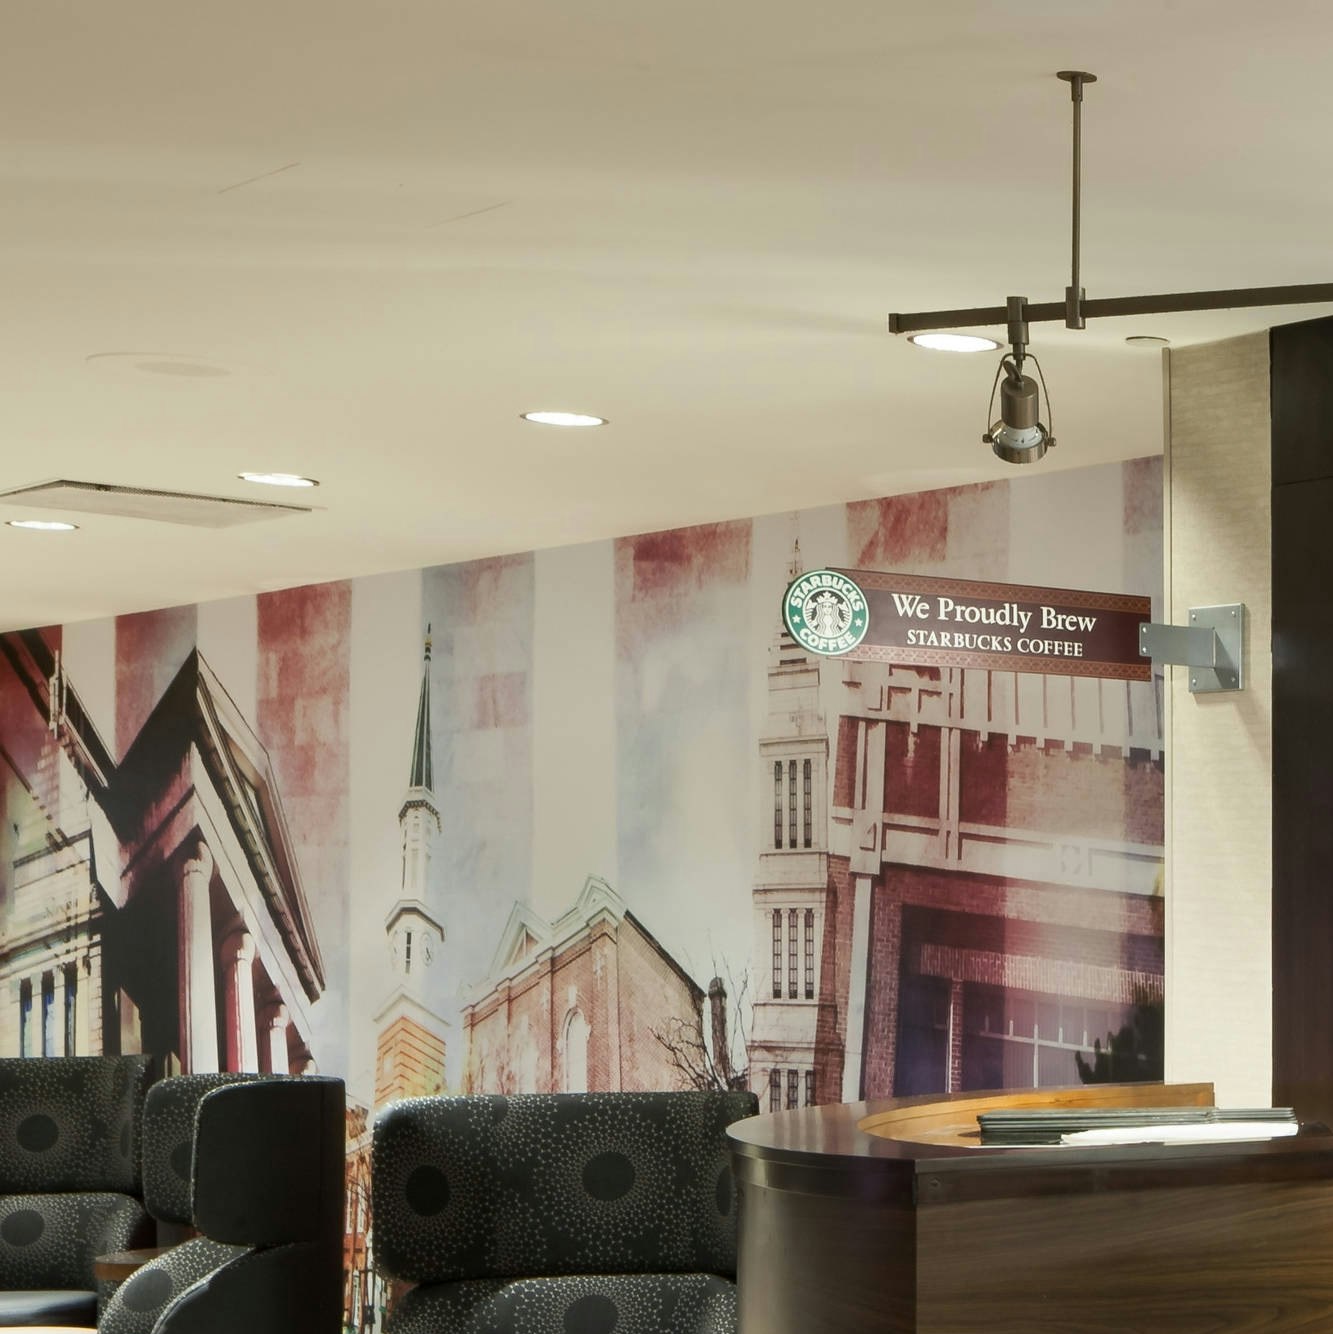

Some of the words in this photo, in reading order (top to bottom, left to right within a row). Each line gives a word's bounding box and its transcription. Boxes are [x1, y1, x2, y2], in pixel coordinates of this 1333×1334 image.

[790, 575, 864, 611] STARBUCKS
[891, 594, 930, 619] We
[938, 597, 1031, 633] Proudly
[1041, 606, 1097, 633] Brew
[800, 628, 857, 651] COFFEE
[906, 629, 1011, 653] STARBUCKS
[1017, 637, 1084, 658] COFFEE
